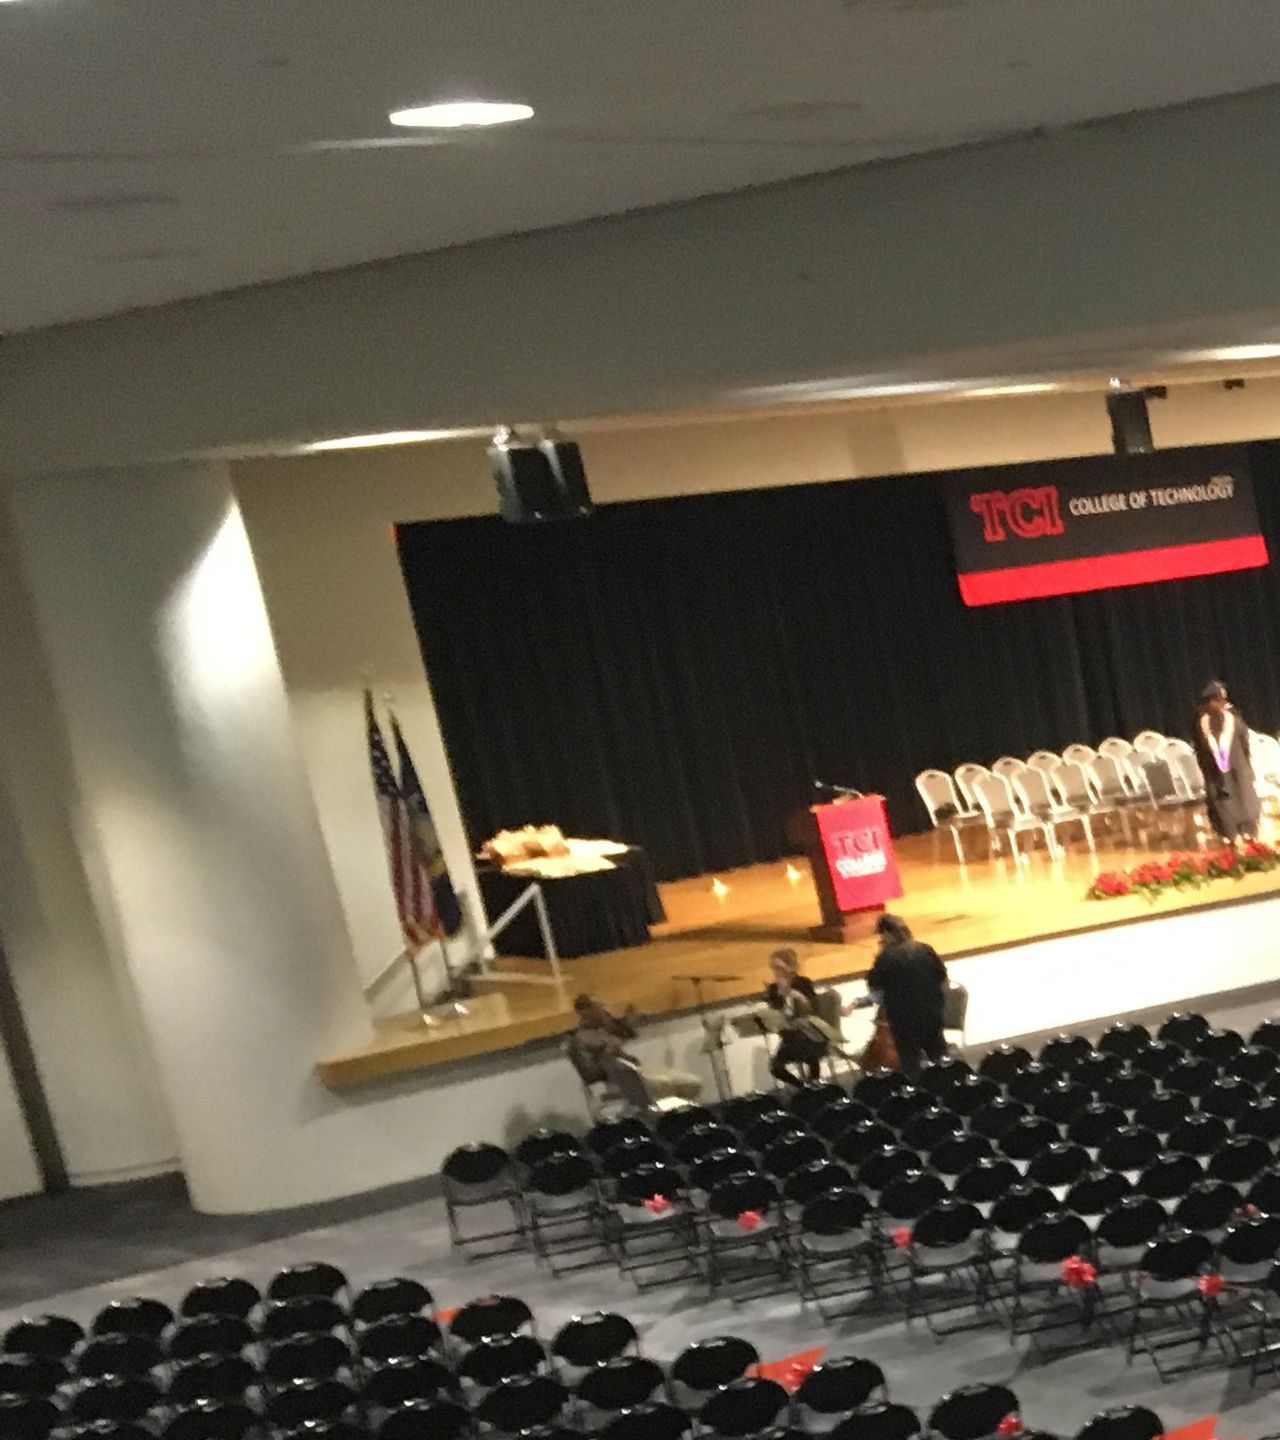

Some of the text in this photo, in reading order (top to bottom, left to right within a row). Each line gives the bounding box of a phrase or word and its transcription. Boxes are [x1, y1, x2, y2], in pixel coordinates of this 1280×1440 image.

[971, 485, 1064, 542] TCI
[1069, 484, 1234, 515] COLLEGE OF TECHNOLOGY
[835, 828, 880, 856] TCI
